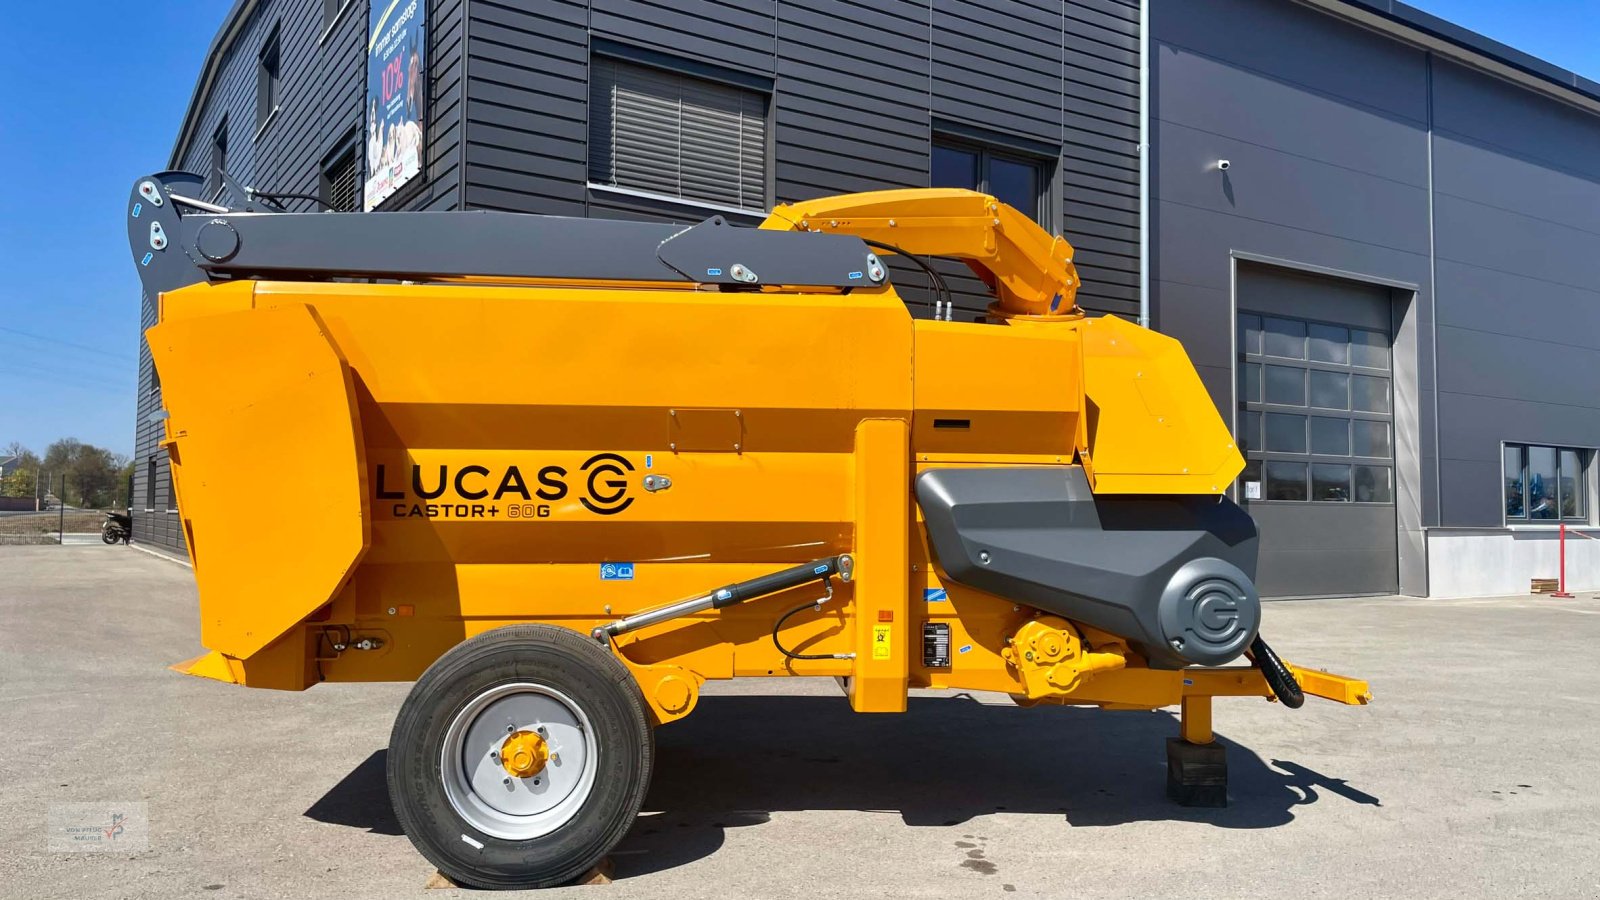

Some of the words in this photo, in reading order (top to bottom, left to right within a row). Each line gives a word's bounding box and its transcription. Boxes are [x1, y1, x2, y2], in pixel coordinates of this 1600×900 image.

[375, 30, 391, 57] immer
[391, 0, 418, 37] samstags
[376, 464, 568, 500] LUCAS
[392, 504, 500, 518] CASTOR+
[507, 504, 551, 518] 60G
